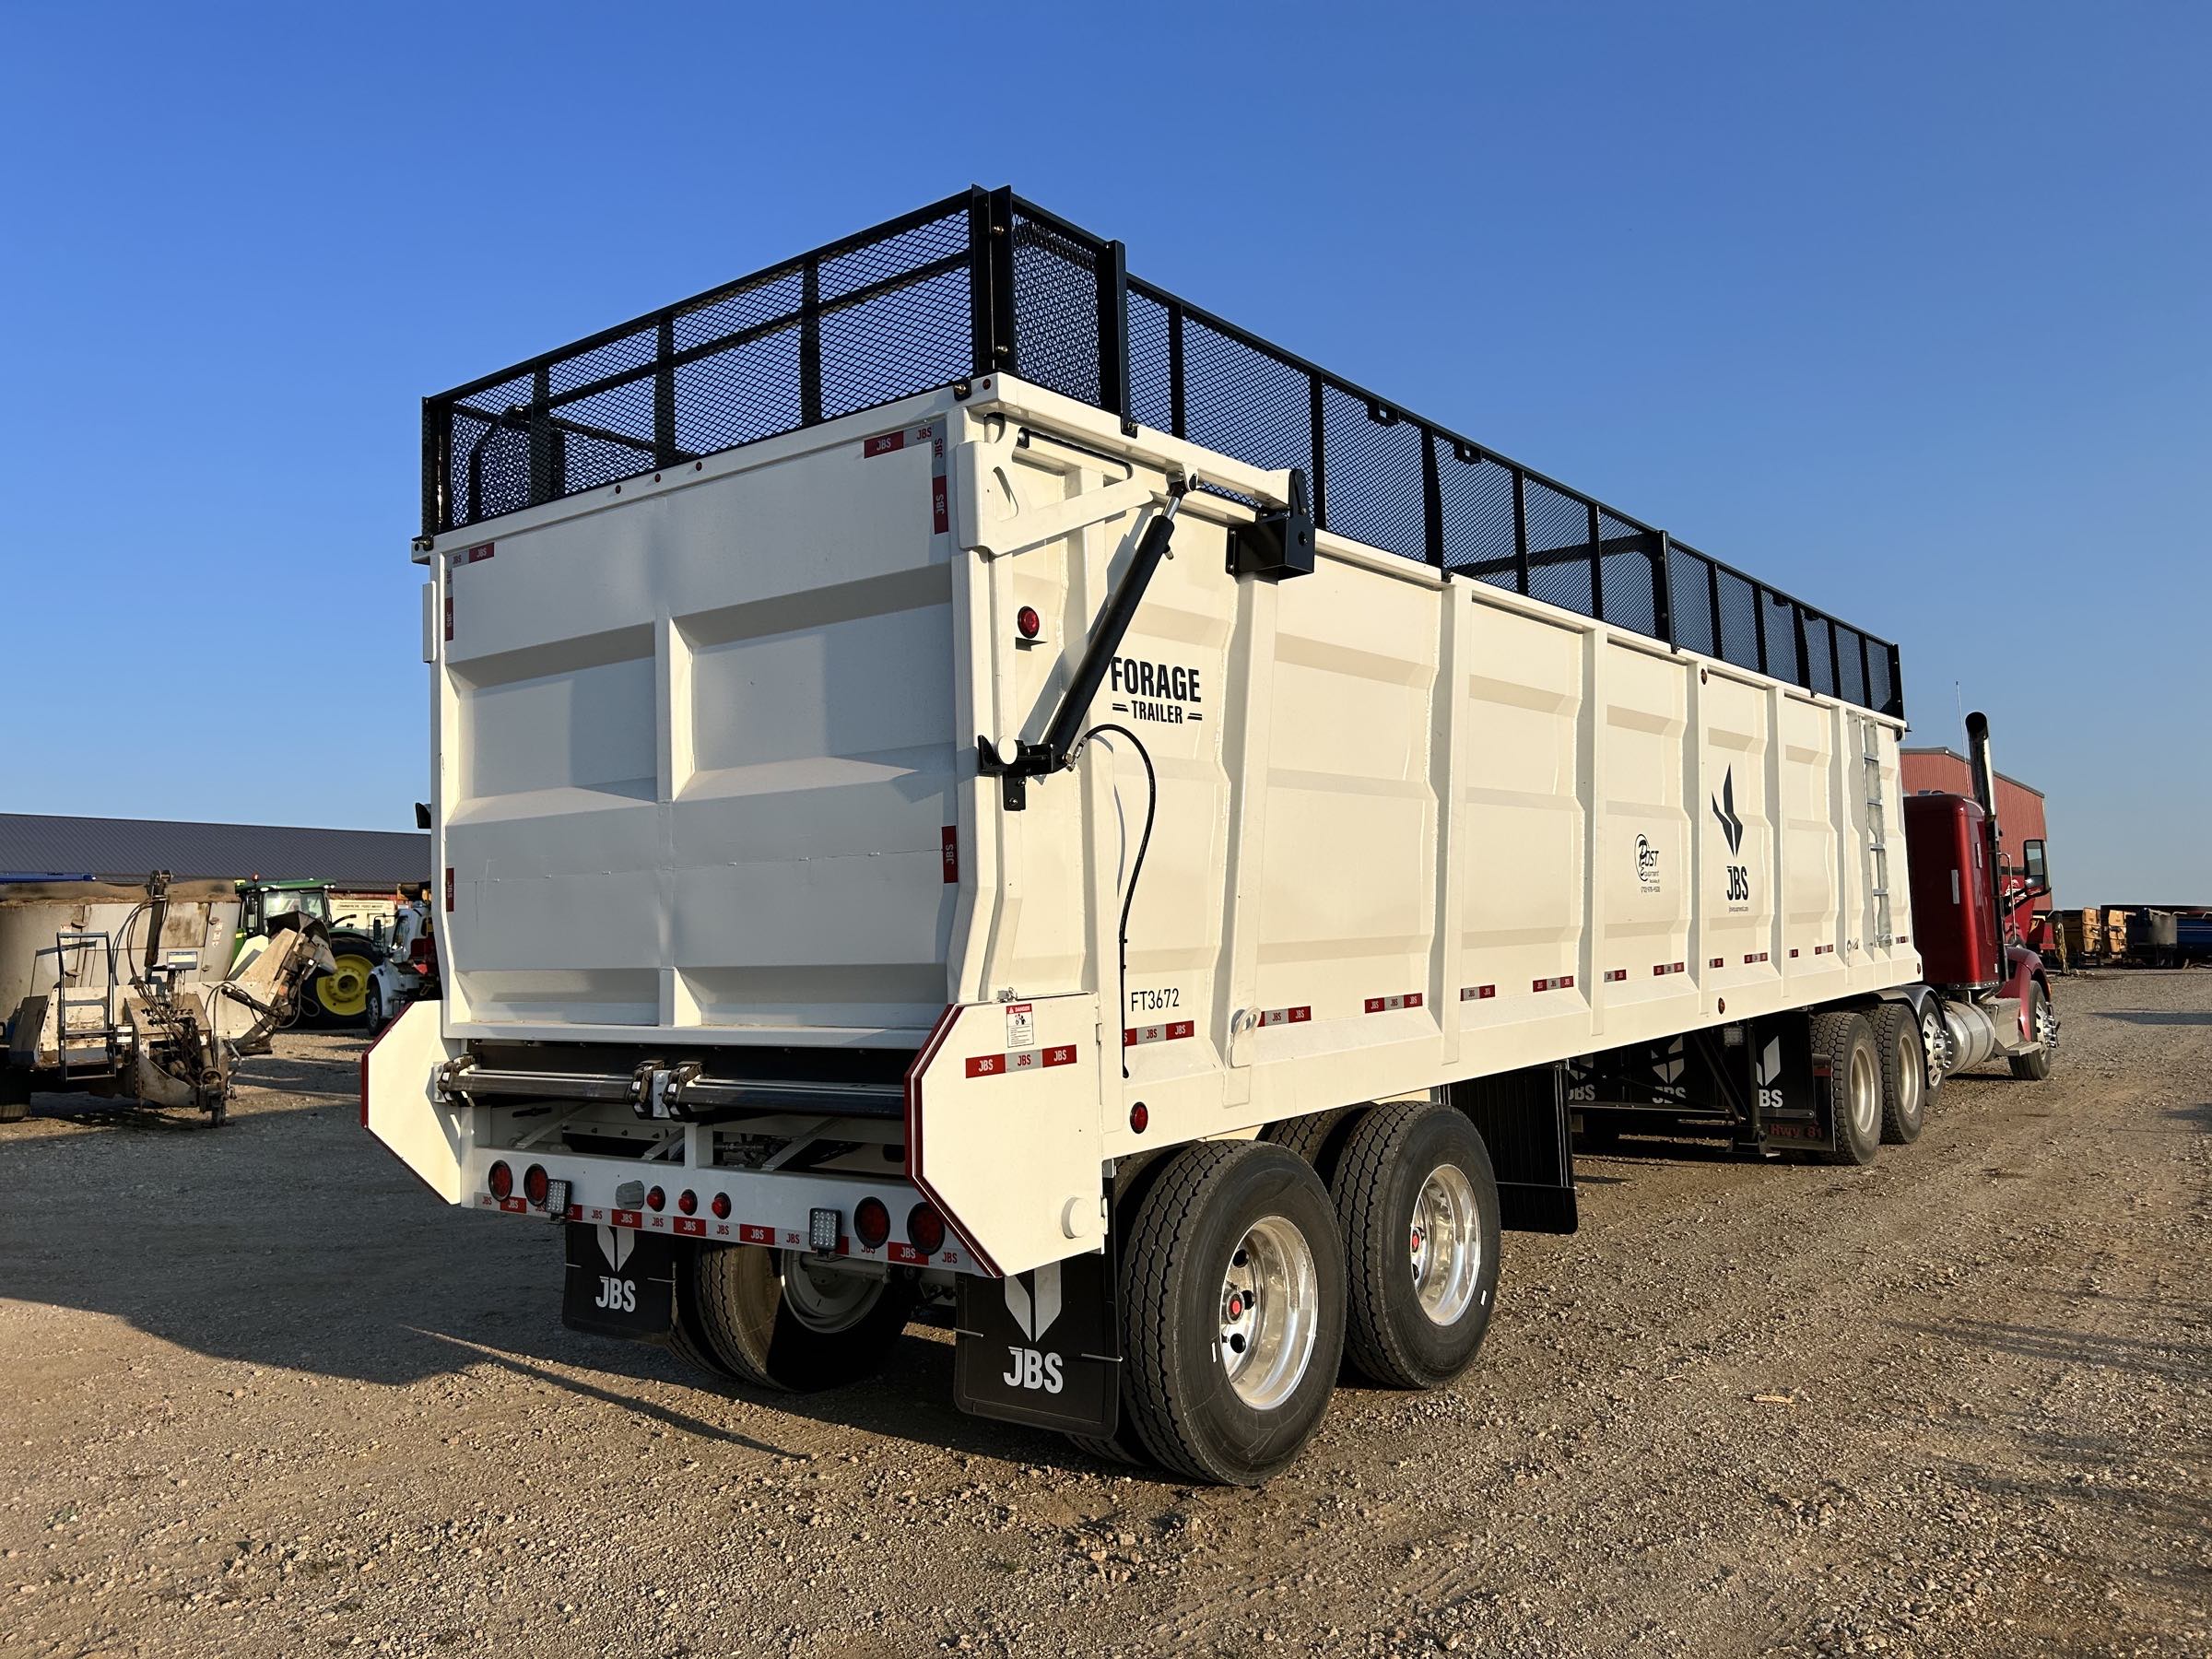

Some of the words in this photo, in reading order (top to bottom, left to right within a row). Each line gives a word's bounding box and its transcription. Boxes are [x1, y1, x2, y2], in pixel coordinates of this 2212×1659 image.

[877, 438, 891, 452] JBS
[916, 427, 932, 441] JBS
[935, 438, 943, 458] JBS
[935, 494, 945, 514] JBS
[477, 547, 488, 558] JBS
[1110, 656, 1201, 702] FORAGE
[1131, 700, 1182, 724] TRAILER
[946, 843, 955, 865] JBS
[1726, 865, 1749, 900] JBS
[1131, 988, 1180, 1012] FT3672
[1272, 1012, 1282, 1022] JBS
[1295, 1009, 1305, 1018] JBS
[1146, 1028, 1158, 1040] JBS
[1174, 1024, 1186, 1035] JBS
[978, 1058, 994, 1072] JBS
[1017, 1053, 1031, 1066] JBS
[1053, 1049, 1067, 1062] JBS
[1759, 1088, 1783, 1108] BS
[482, 1196, 492, 1206] JBS
[508, 1199, 519, 1209] JBS
[591, 1209, 603, 1220] JBS
[620, 1213, 633, 1224] JBS
[652, 1217, 664, 1228] JBS
[683, 1220, 697, 1232] JBS
[716, 1224, 729, 1236] JBS
[750, 1229, 764, 1241] JBS
[786, 1232, 800, 1245] JBS
[900, 1246, 916, 1260] JBS
[942, 1252, 958, 1265] JBS
[595, 1276, 636, 1312] JBS
[1003, 1346, 1064, 1394] JBS
